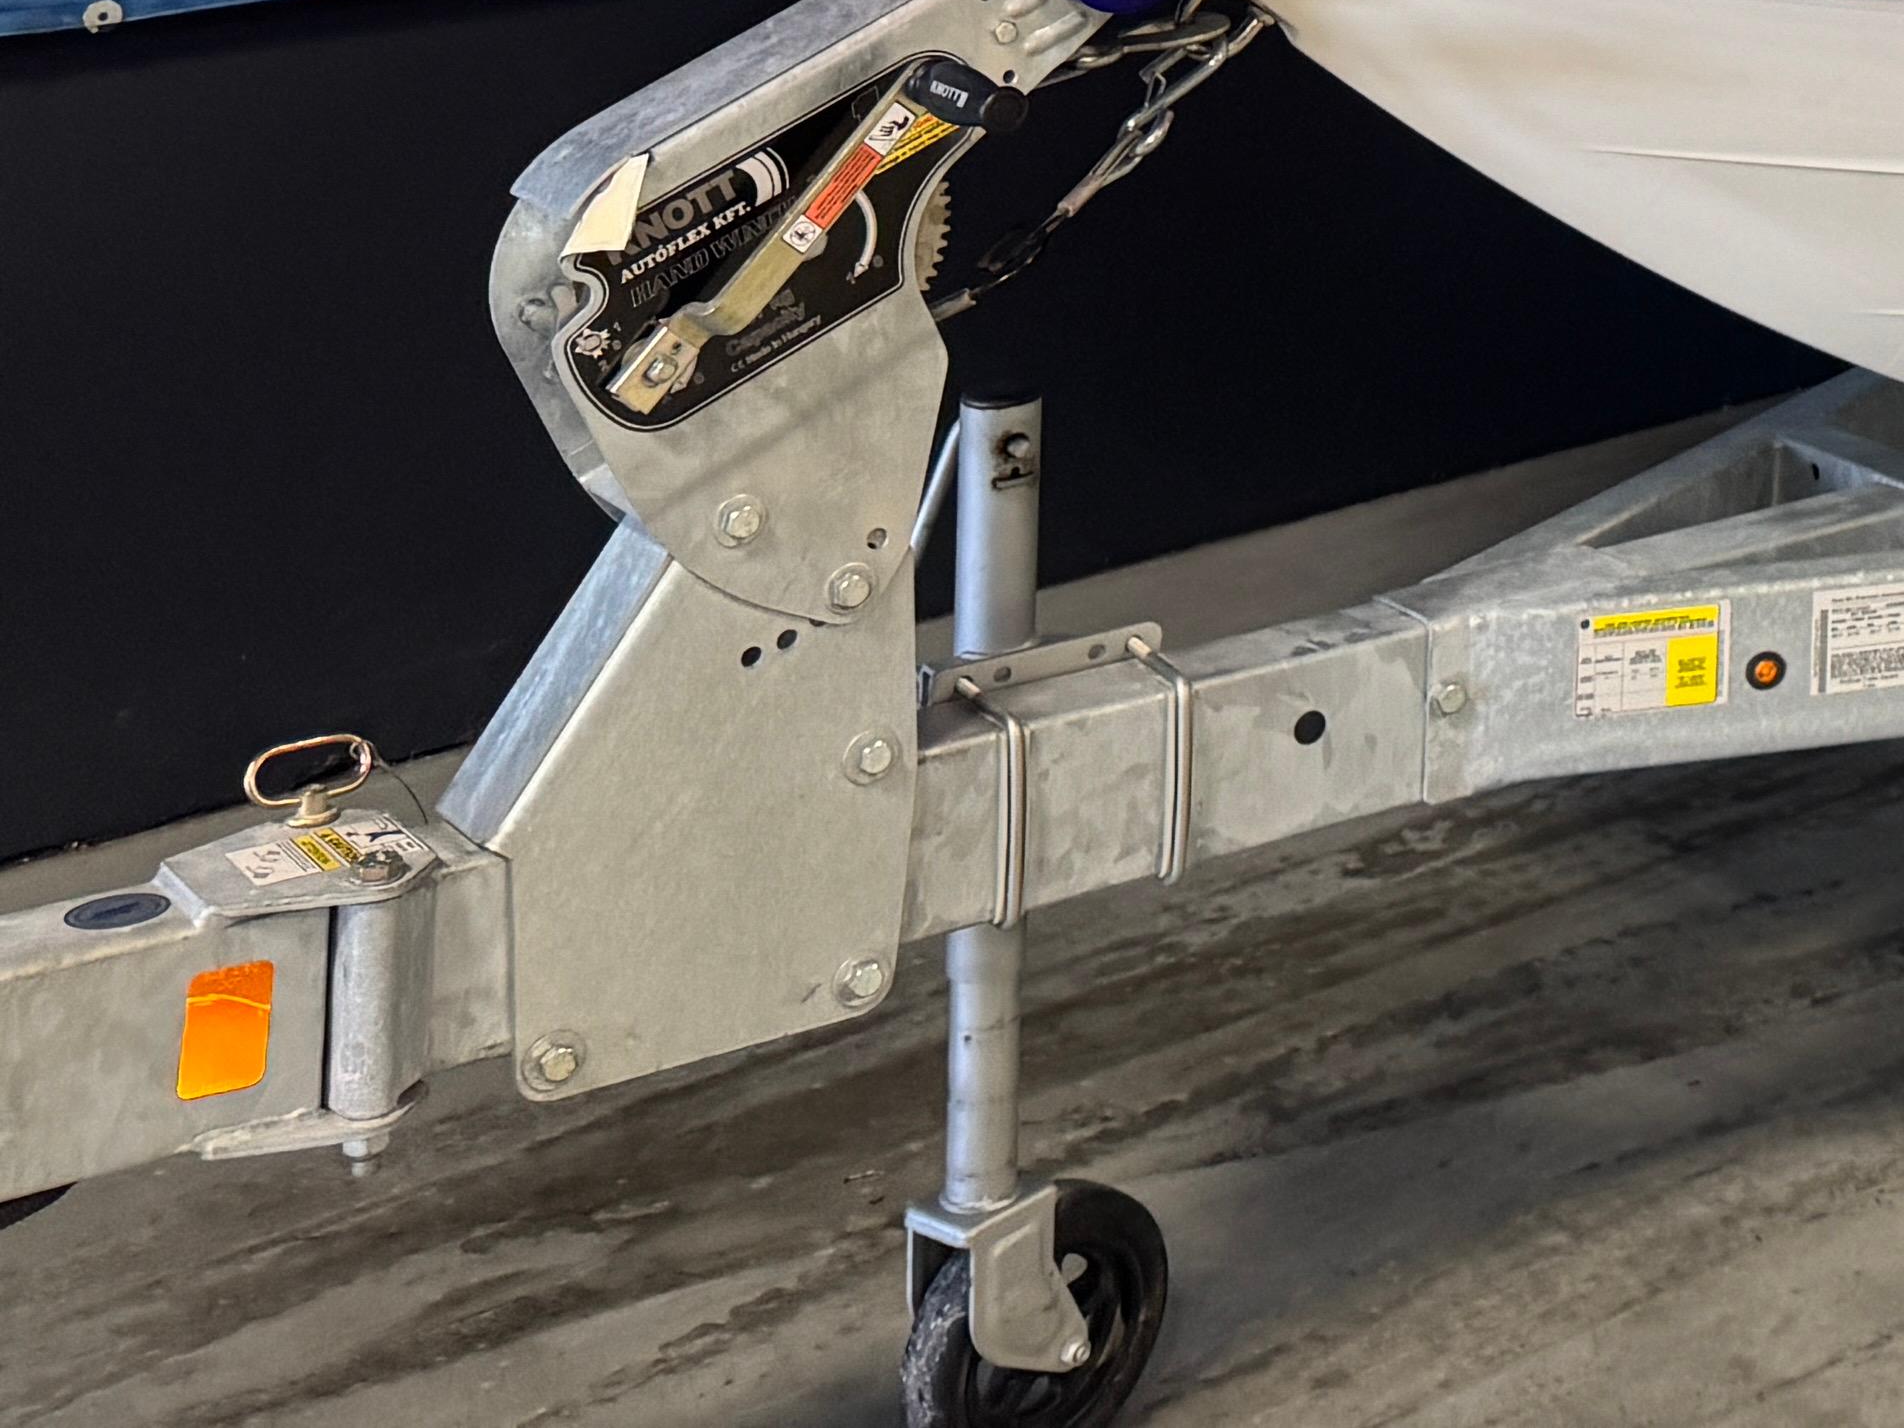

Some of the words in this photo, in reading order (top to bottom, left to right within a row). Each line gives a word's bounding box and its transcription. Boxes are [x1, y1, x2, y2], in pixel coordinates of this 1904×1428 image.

[620, 221, 712, 285] AUTÓFLEX
[712, 201, 753, 231] KFT.
[630, 248, 711, 309] HAND
